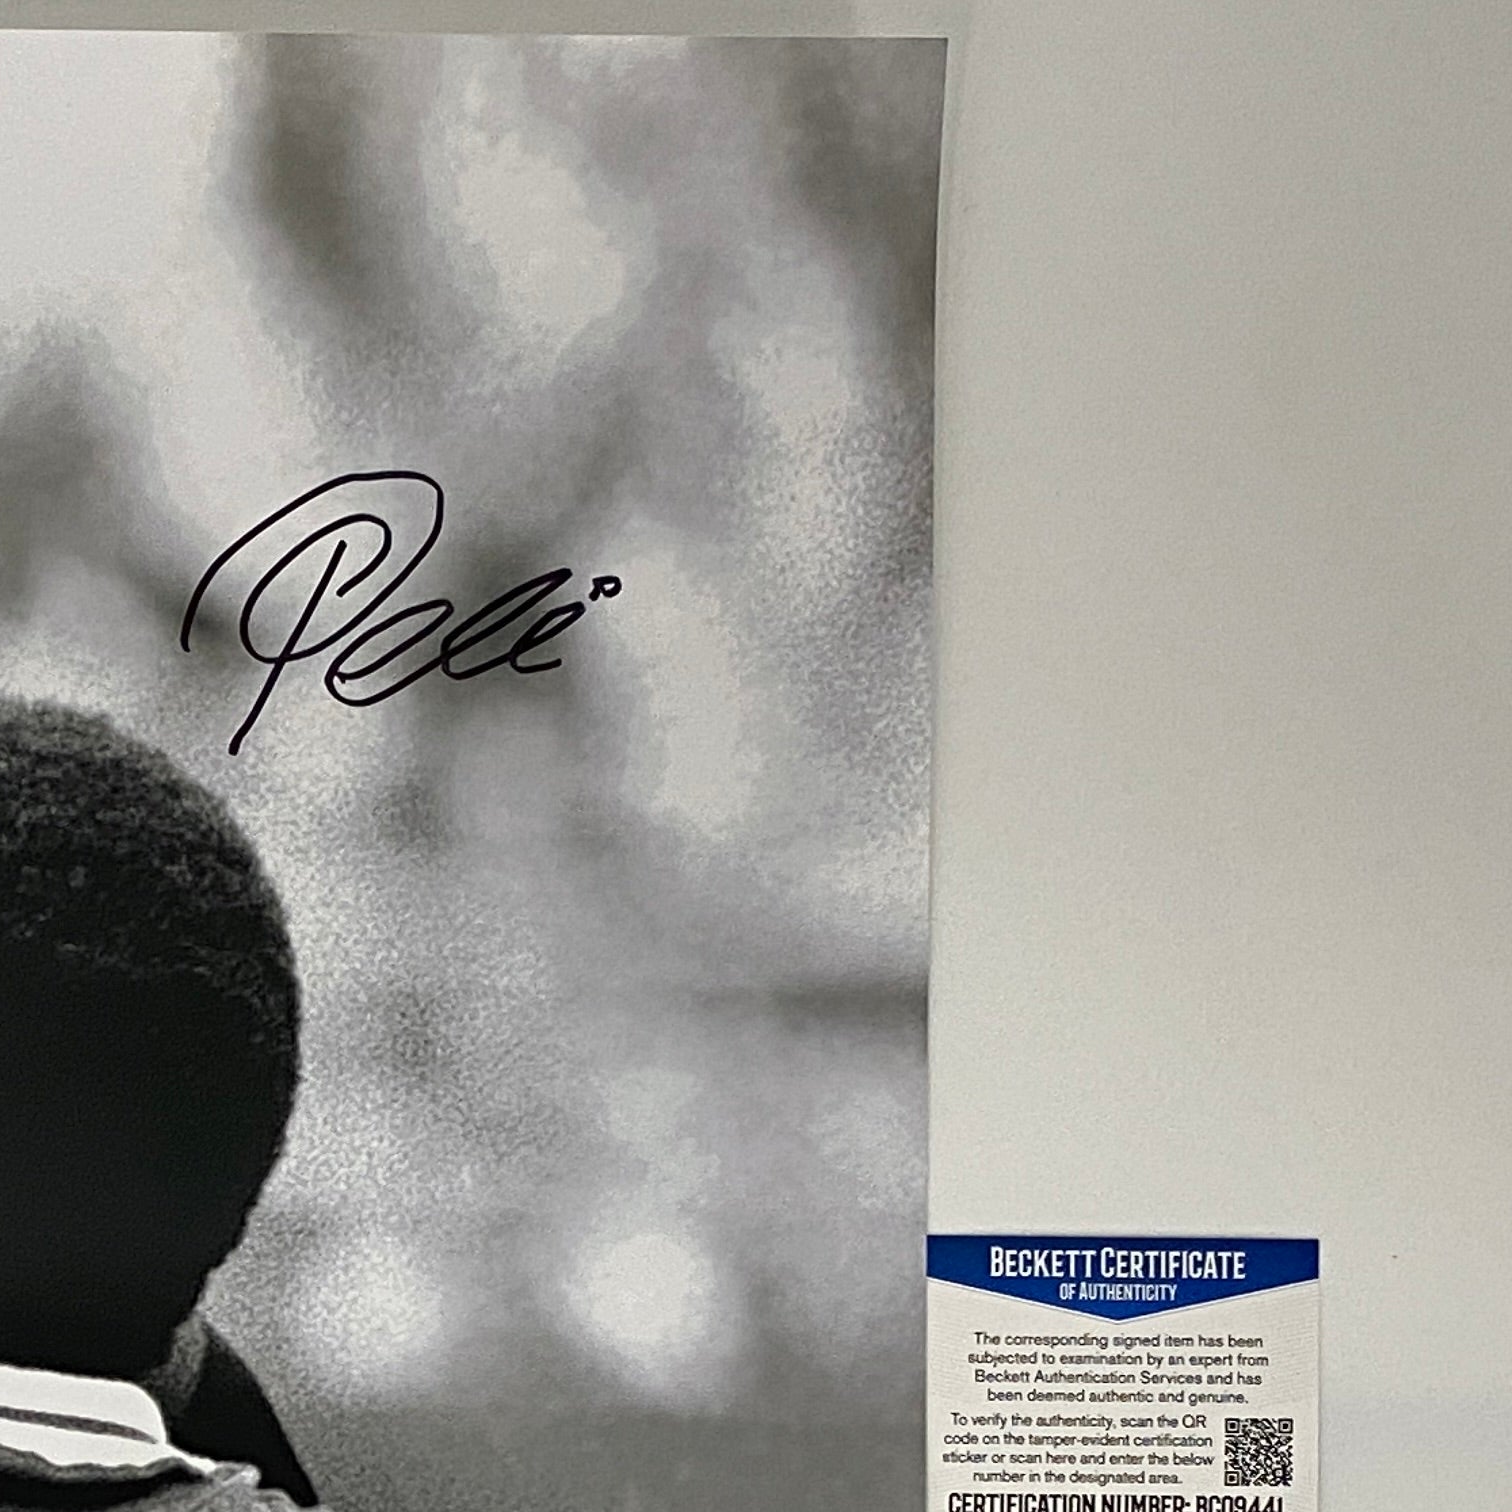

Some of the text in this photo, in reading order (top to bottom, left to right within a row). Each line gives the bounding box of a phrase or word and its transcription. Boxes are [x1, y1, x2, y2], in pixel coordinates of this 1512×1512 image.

[990, 1246, 1246, 1280] BECKETT CERTIFICATE
[1059, 1282, 1177, 1301] OF AUTHENTICITY
[974, 1332, 1263, 1349] The corresponding signed item has been
[968, 1351, 1269, 1368] subjected to examination by an expert from
[975, 1369, 1263, 1385] Beckett Authentication Services and has
[987, 1388, 1249, 1406] been deemed authentic and genuine.
[950, 1412, 1207, 1430] To verify the authenticity, scan the QR
[944, 1432, 1213, 1448] code on the tamper-evident certification
[942, 1449, 1215, 1465] sticker or scan here and enter the below
[973, 1470, 1183, 1486] number in the designated area.
